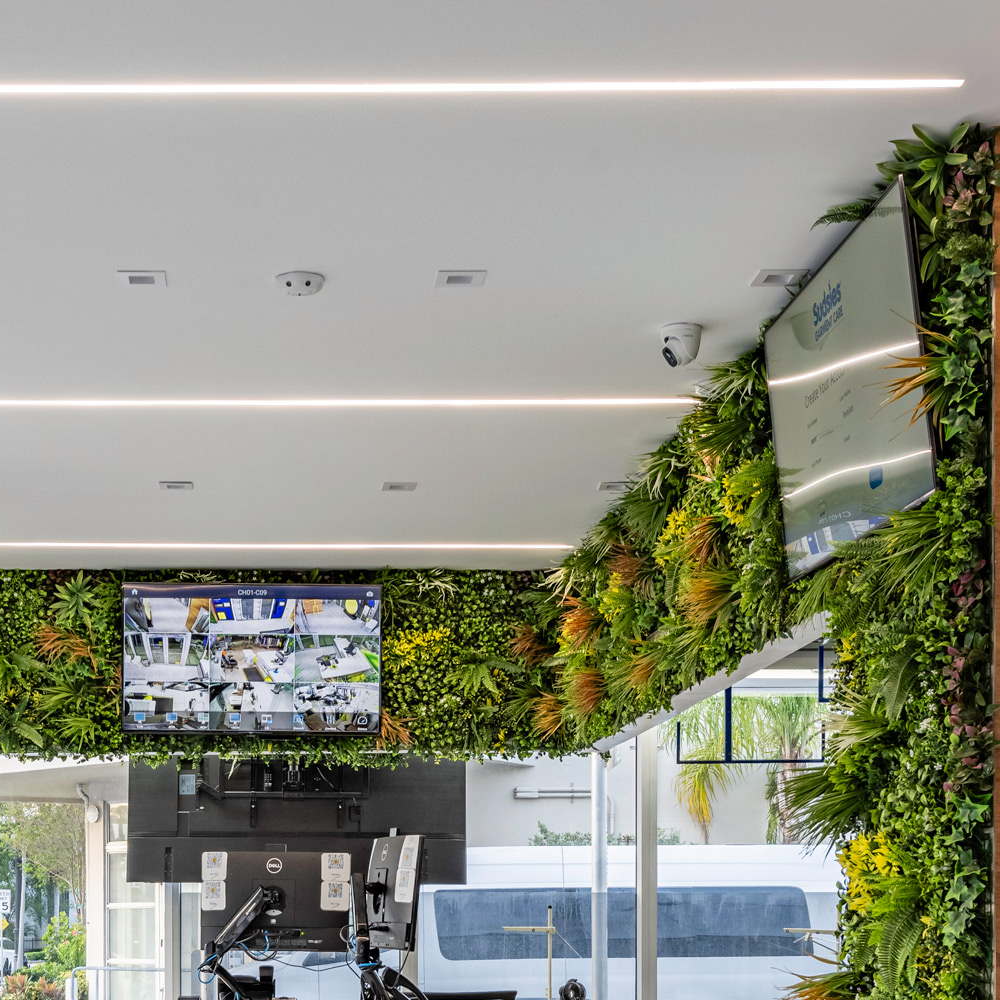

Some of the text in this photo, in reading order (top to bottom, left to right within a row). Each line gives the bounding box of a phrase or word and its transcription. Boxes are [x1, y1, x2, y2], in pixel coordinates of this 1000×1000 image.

[813, 281, 841, 327] Sudsies
[833, 305, 844, 324] CARE
[804, 389, 819, 409] Create
